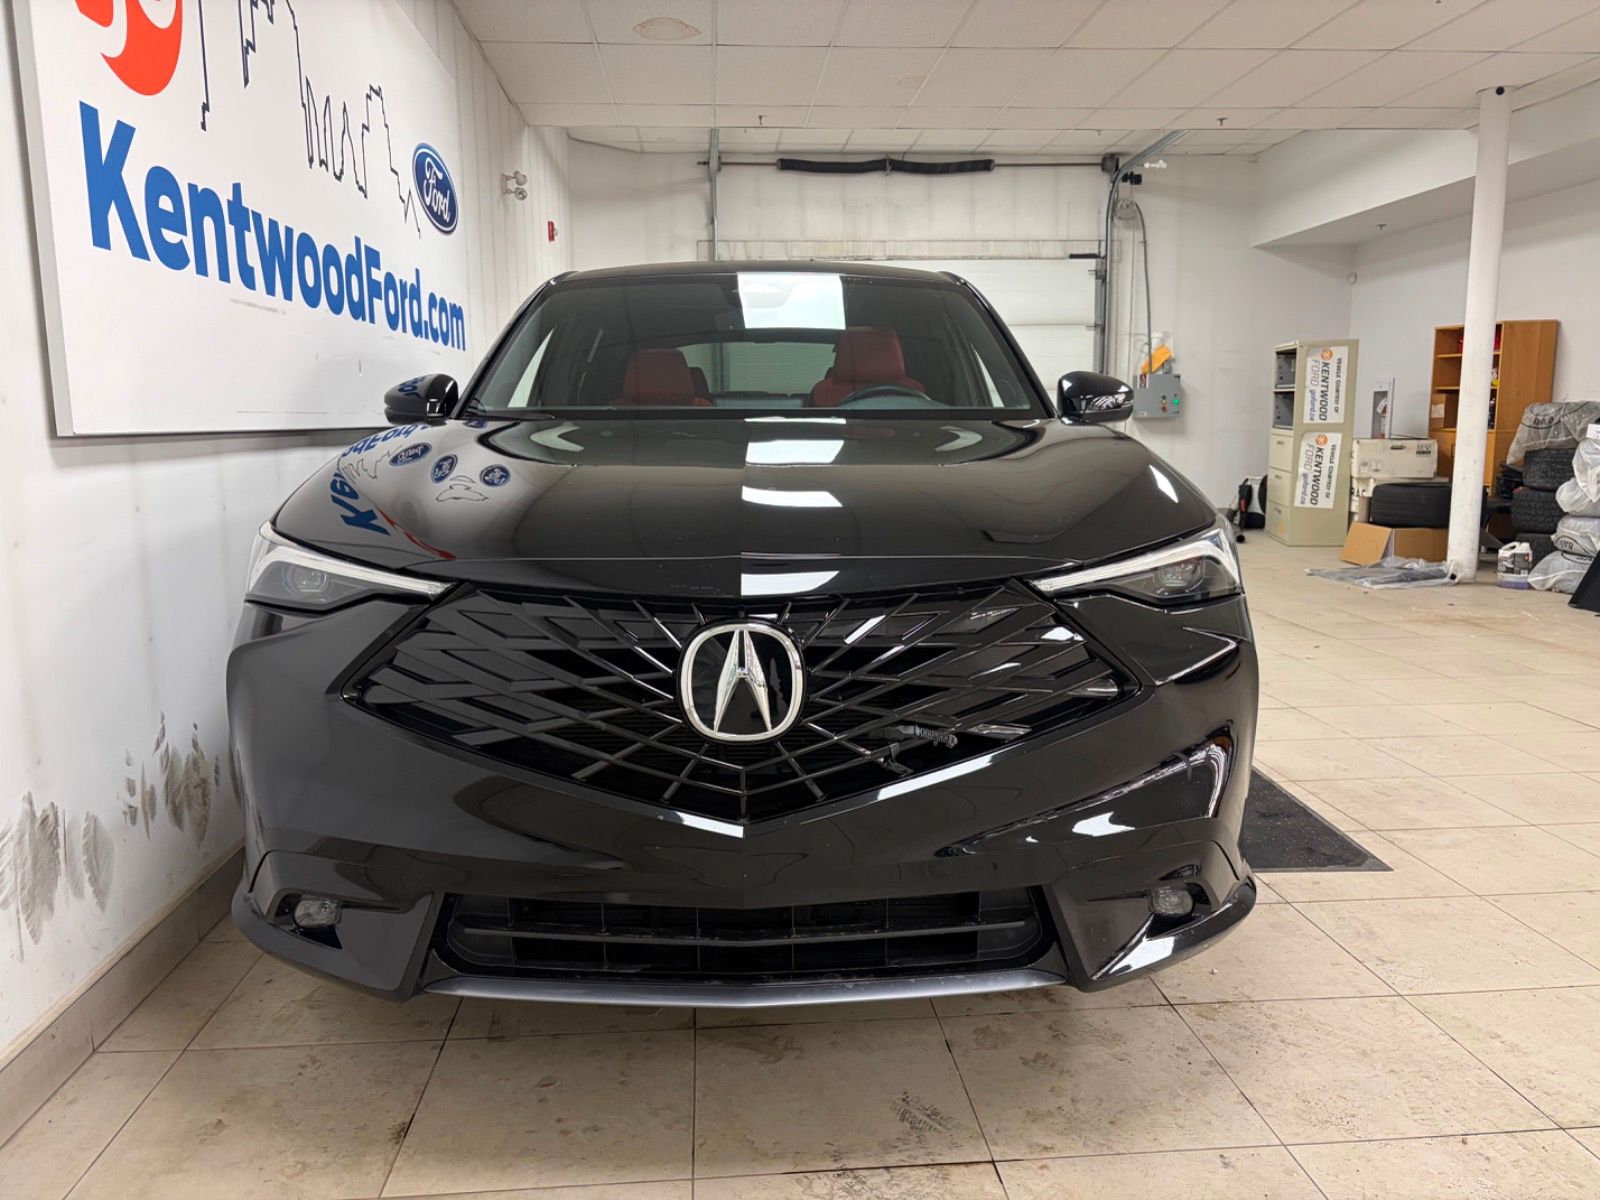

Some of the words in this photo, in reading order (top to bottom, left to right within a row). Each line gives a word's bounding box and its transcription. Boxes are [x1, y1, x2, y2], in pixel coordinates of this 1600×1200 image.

[423, 157, 451, 222] Ford
[79, 100, 466, 351] KentwoodFord.com
[1310, 359, 1320, 387] FORD
[1335, 358, 1343, 379] VEHICLE
[1308, 389, 1317, 421] goford.ca
[1319, 361, 1331, 421] KENTWOOD
[1334, 380, 1342, 405] COURTESY
[1303, 443, 1315, 471] FORD
[1300, 472, 1309, 505] goford.ca
[1310, 446, 1325, 506] KENTWOOD
